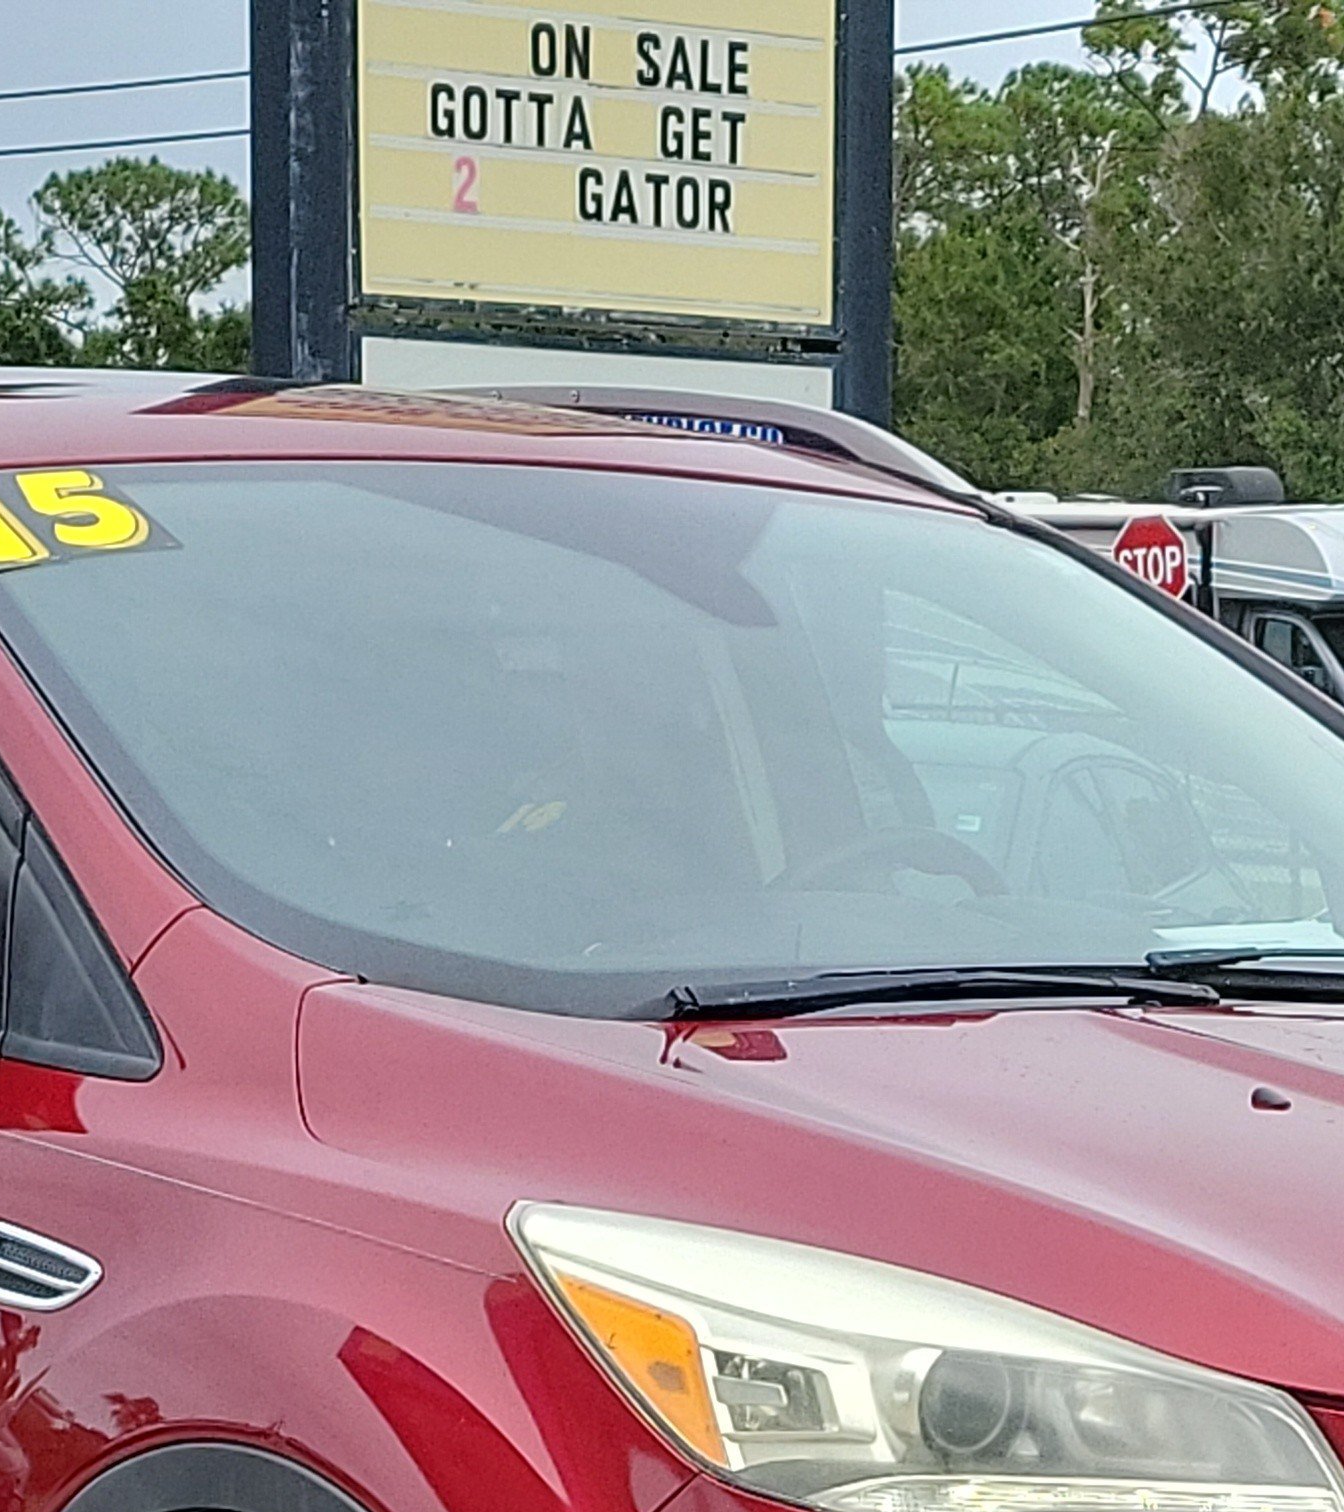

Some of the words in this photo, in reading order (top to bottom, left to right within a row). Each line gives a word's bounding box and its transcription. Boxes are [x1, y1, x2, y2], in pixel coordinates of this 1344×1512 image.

[530, 22, 591, 81] ON
[636, 31, 749, 95] SALE
[430, 82, 594, 151] GOTTA
[660, 105, 746, 165] GET
[454, 155, 478, 214] 2
[578, 166, 732, 234] GATOR
[1119, 545, 1182, 585] STOP
